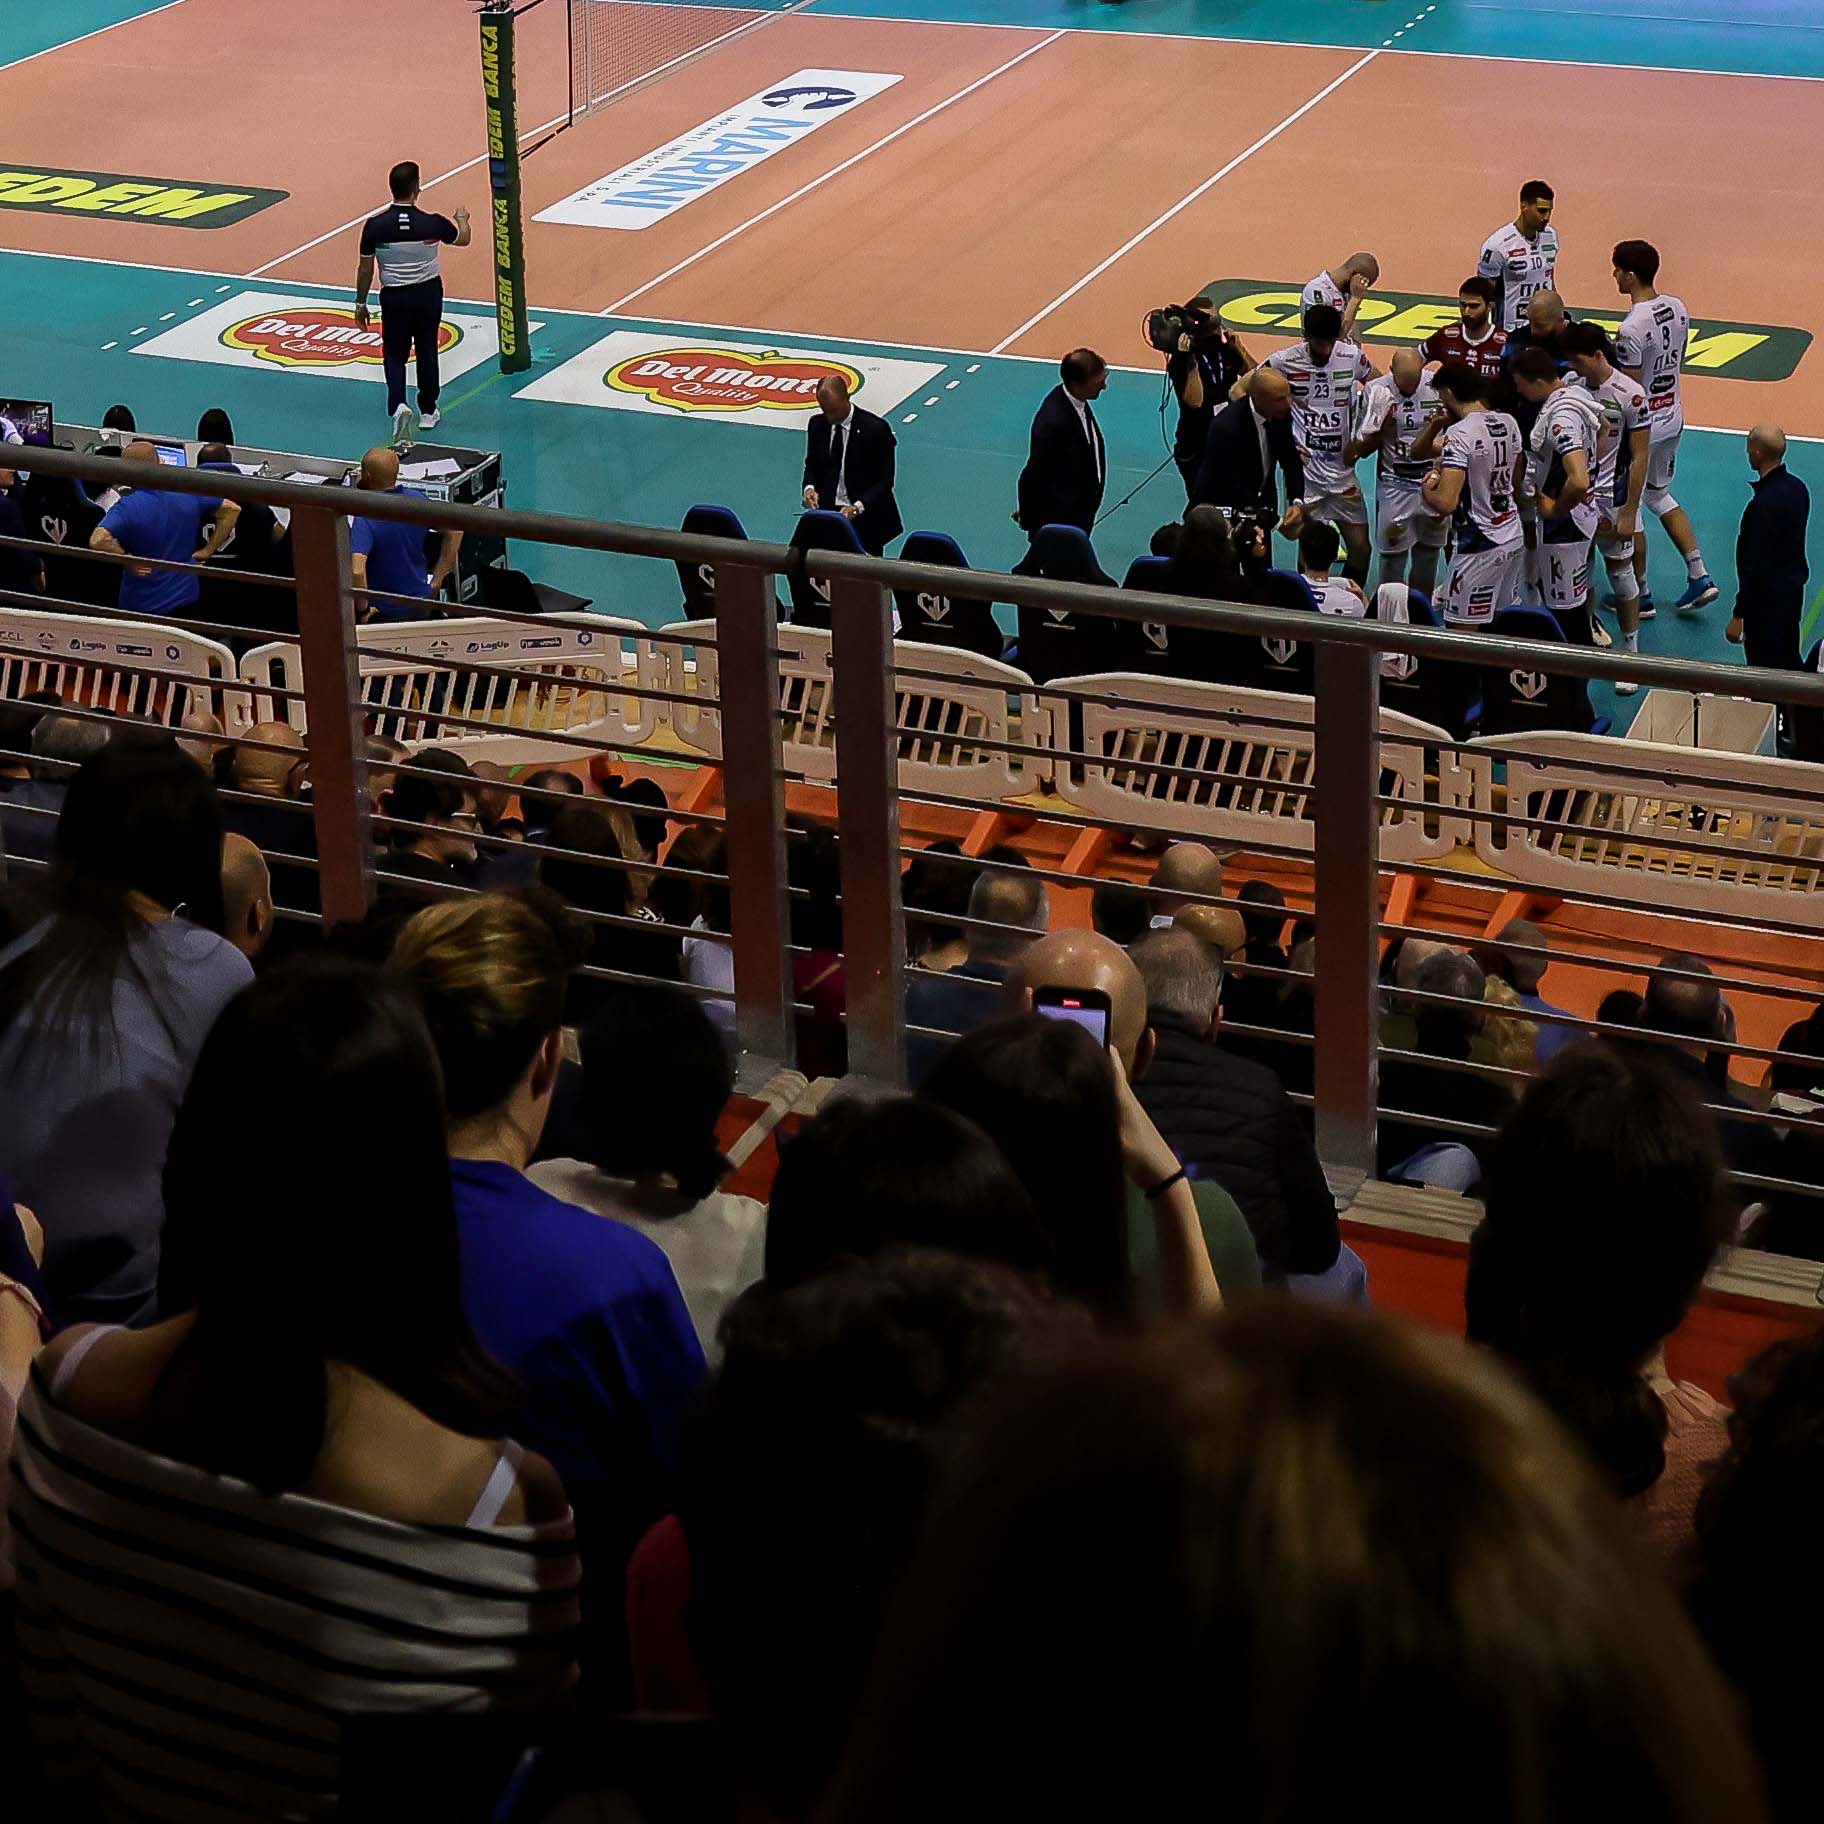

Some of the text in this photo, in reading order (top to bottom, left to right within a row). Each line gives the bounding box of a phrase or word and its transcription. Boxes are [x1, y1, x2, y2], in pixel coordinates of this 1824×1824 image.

[481, 25, 499, 98] BANCA
[490, 104, 501, 159] EDEM
[600, 116, 815, 209] MARINI
[497, 198, 508, 269] BANCA
[1531, 257, 1543, 270] 10
[500, 275, 516, 356] CREDEM
[254, 318, 320, 341] Del
[1661, 326, 1670, 351] 8
[281, 338, 361, 359] Quality
[629, 360, 820, 393] Del Mont
[671, 382, 760, 402] Quality
[1314, 383, 1330, 398] 23
[1304, 412, 1341, 428] ITAS
[1405, 413, 1415, 427] 6
[1493, 440, 1508, 469] 11
